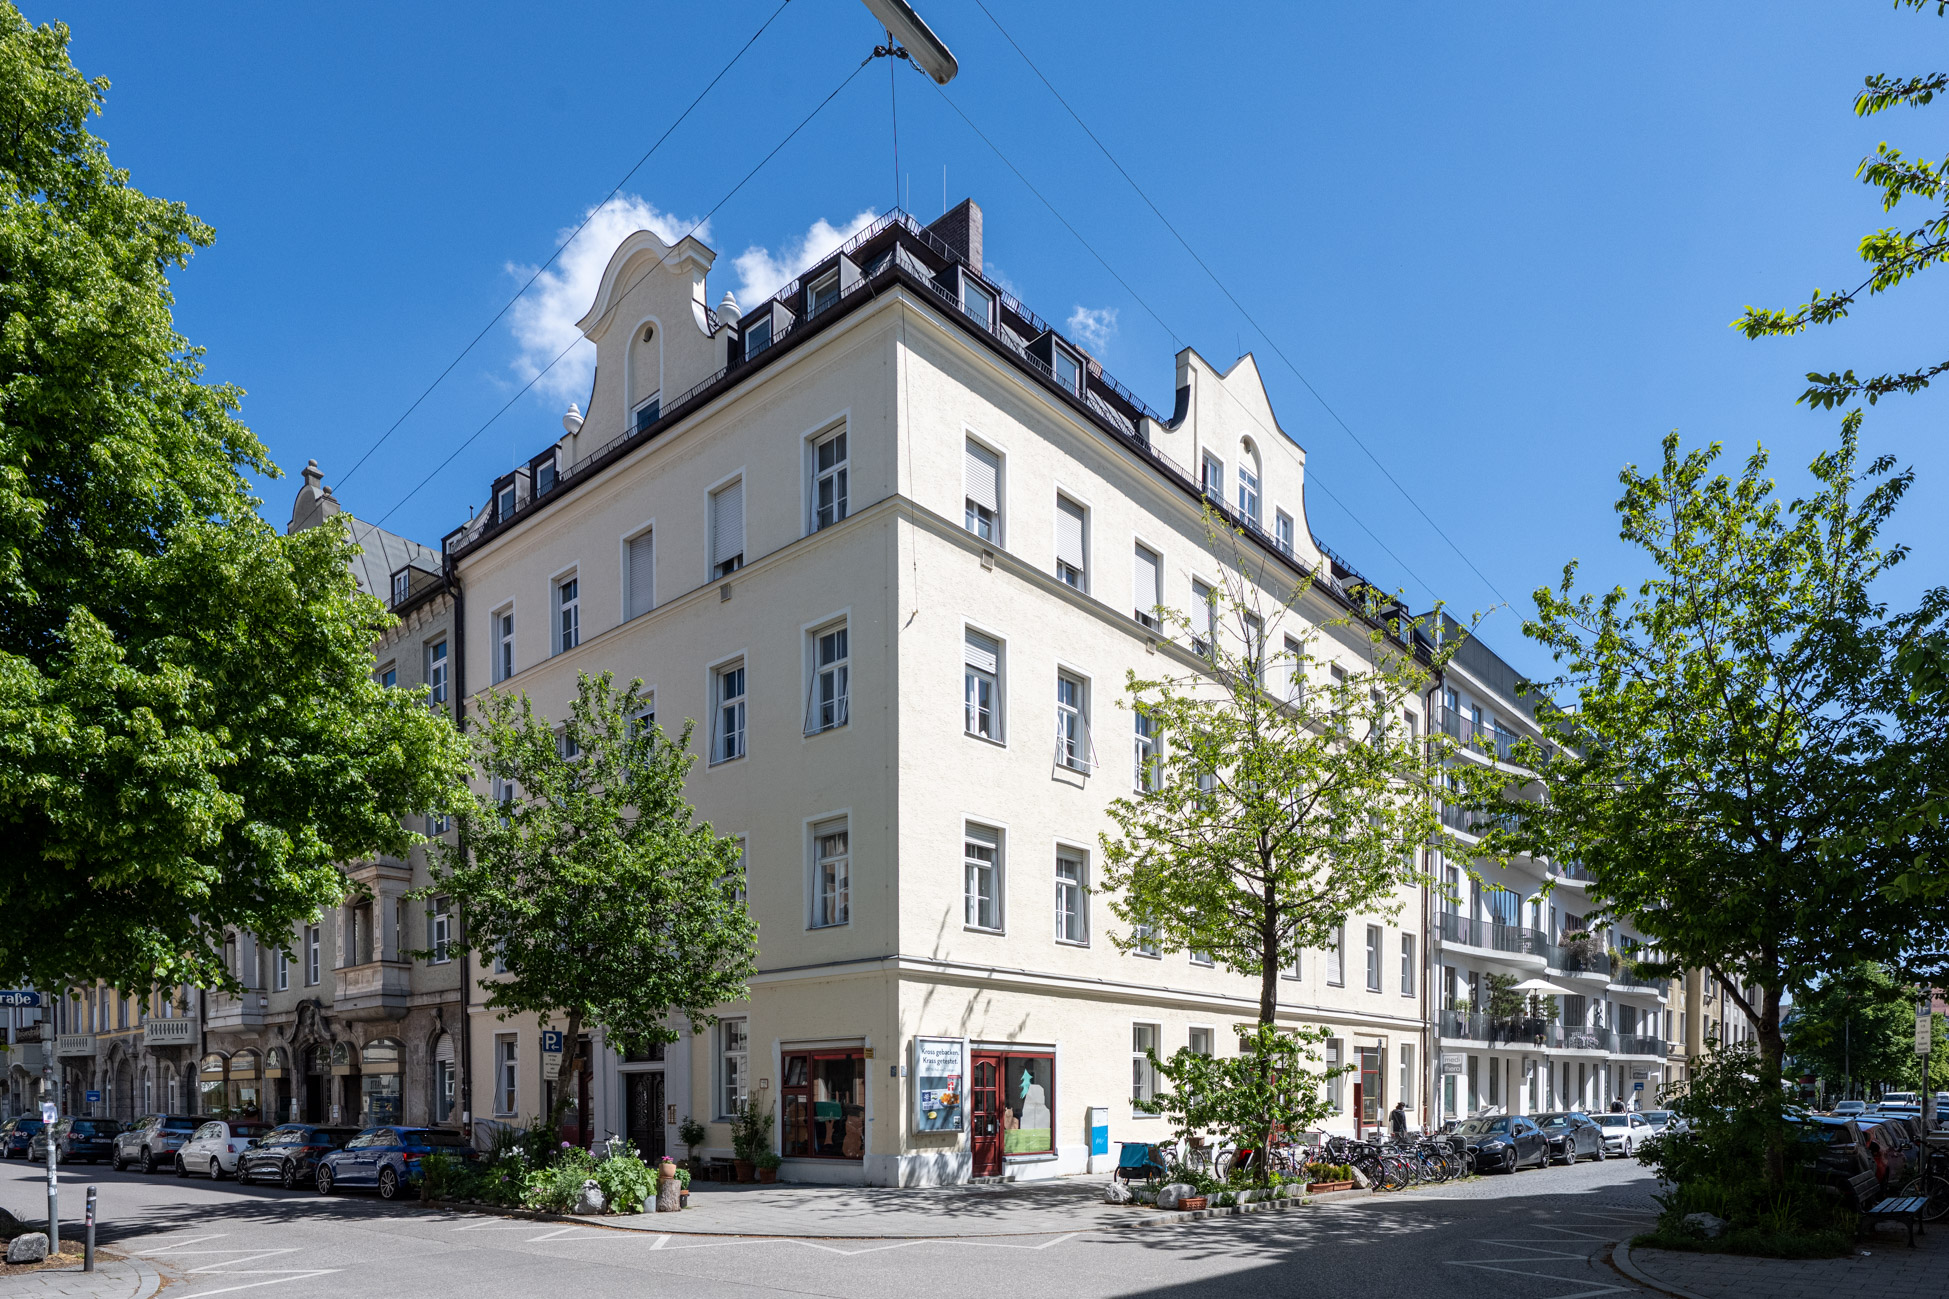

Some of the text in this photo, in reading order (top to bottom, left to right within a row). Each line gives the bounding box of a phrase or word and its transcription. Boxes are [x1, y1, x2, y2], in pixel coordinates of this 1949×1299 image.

[0, 993, 31, 1006] raße
[546, 1033, 557, 1050] P
[936, 1049, 960, 1057] gebacken.
